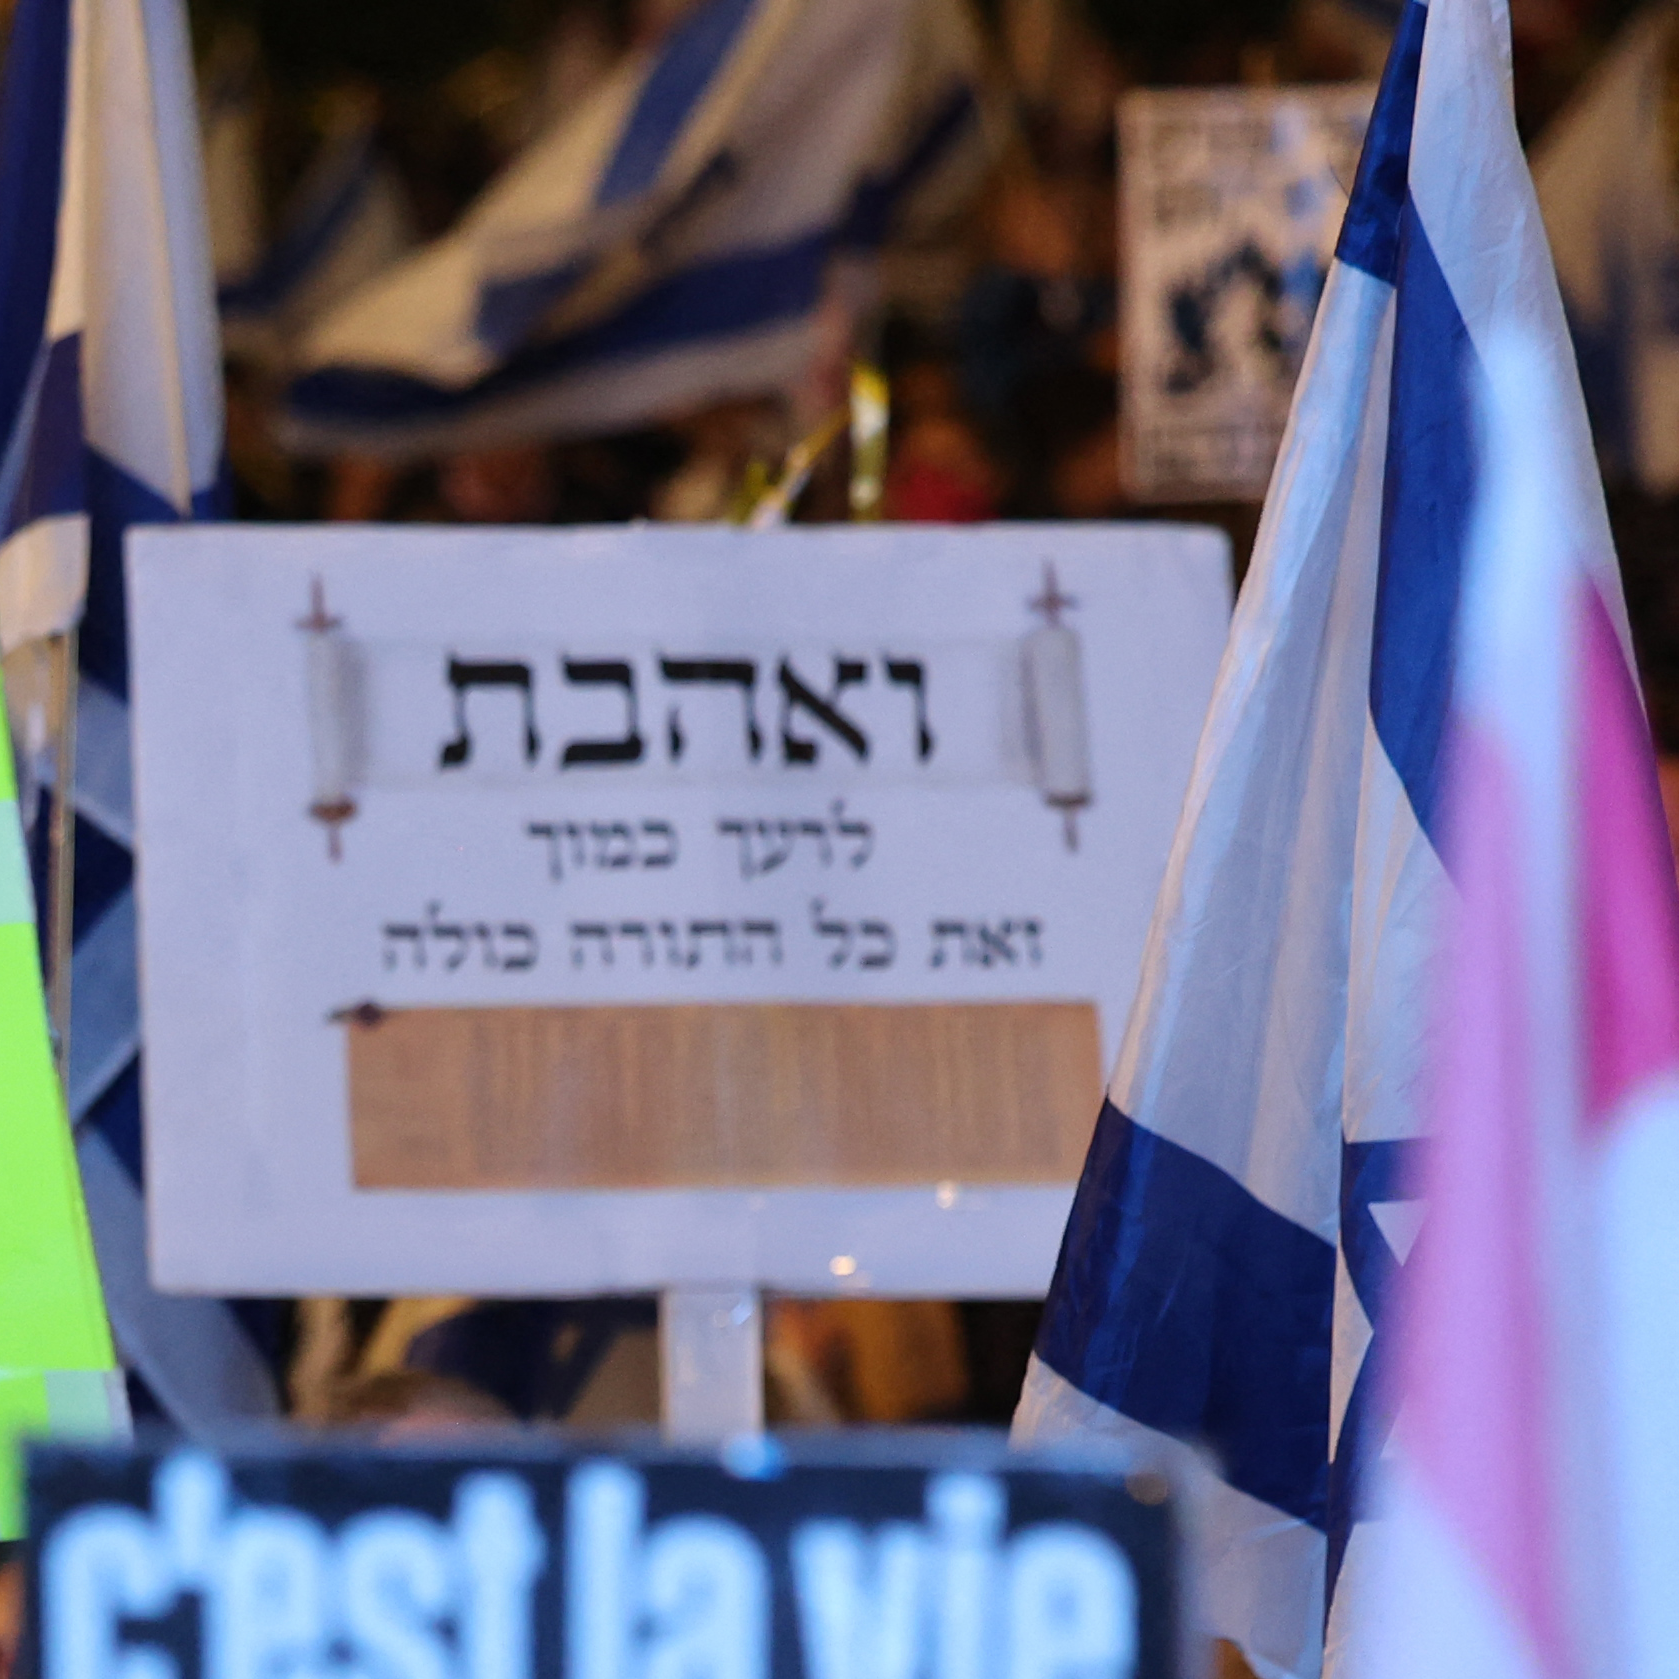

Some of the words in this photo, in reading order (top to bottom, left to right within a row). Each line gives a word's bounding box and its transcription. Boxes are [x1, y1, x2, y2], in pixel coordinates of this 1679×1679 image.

[439, 652, 934, 770] ואהבת
[527, 816, 680, 883] כמוך
[717, 797, 874, 881] לרעך
[381, 898, 538, 973] כולה
[568, 917, 784, 971] התורה
[813, 896, 897, 971] כל
[929, 916, 1043, 971] זאת
